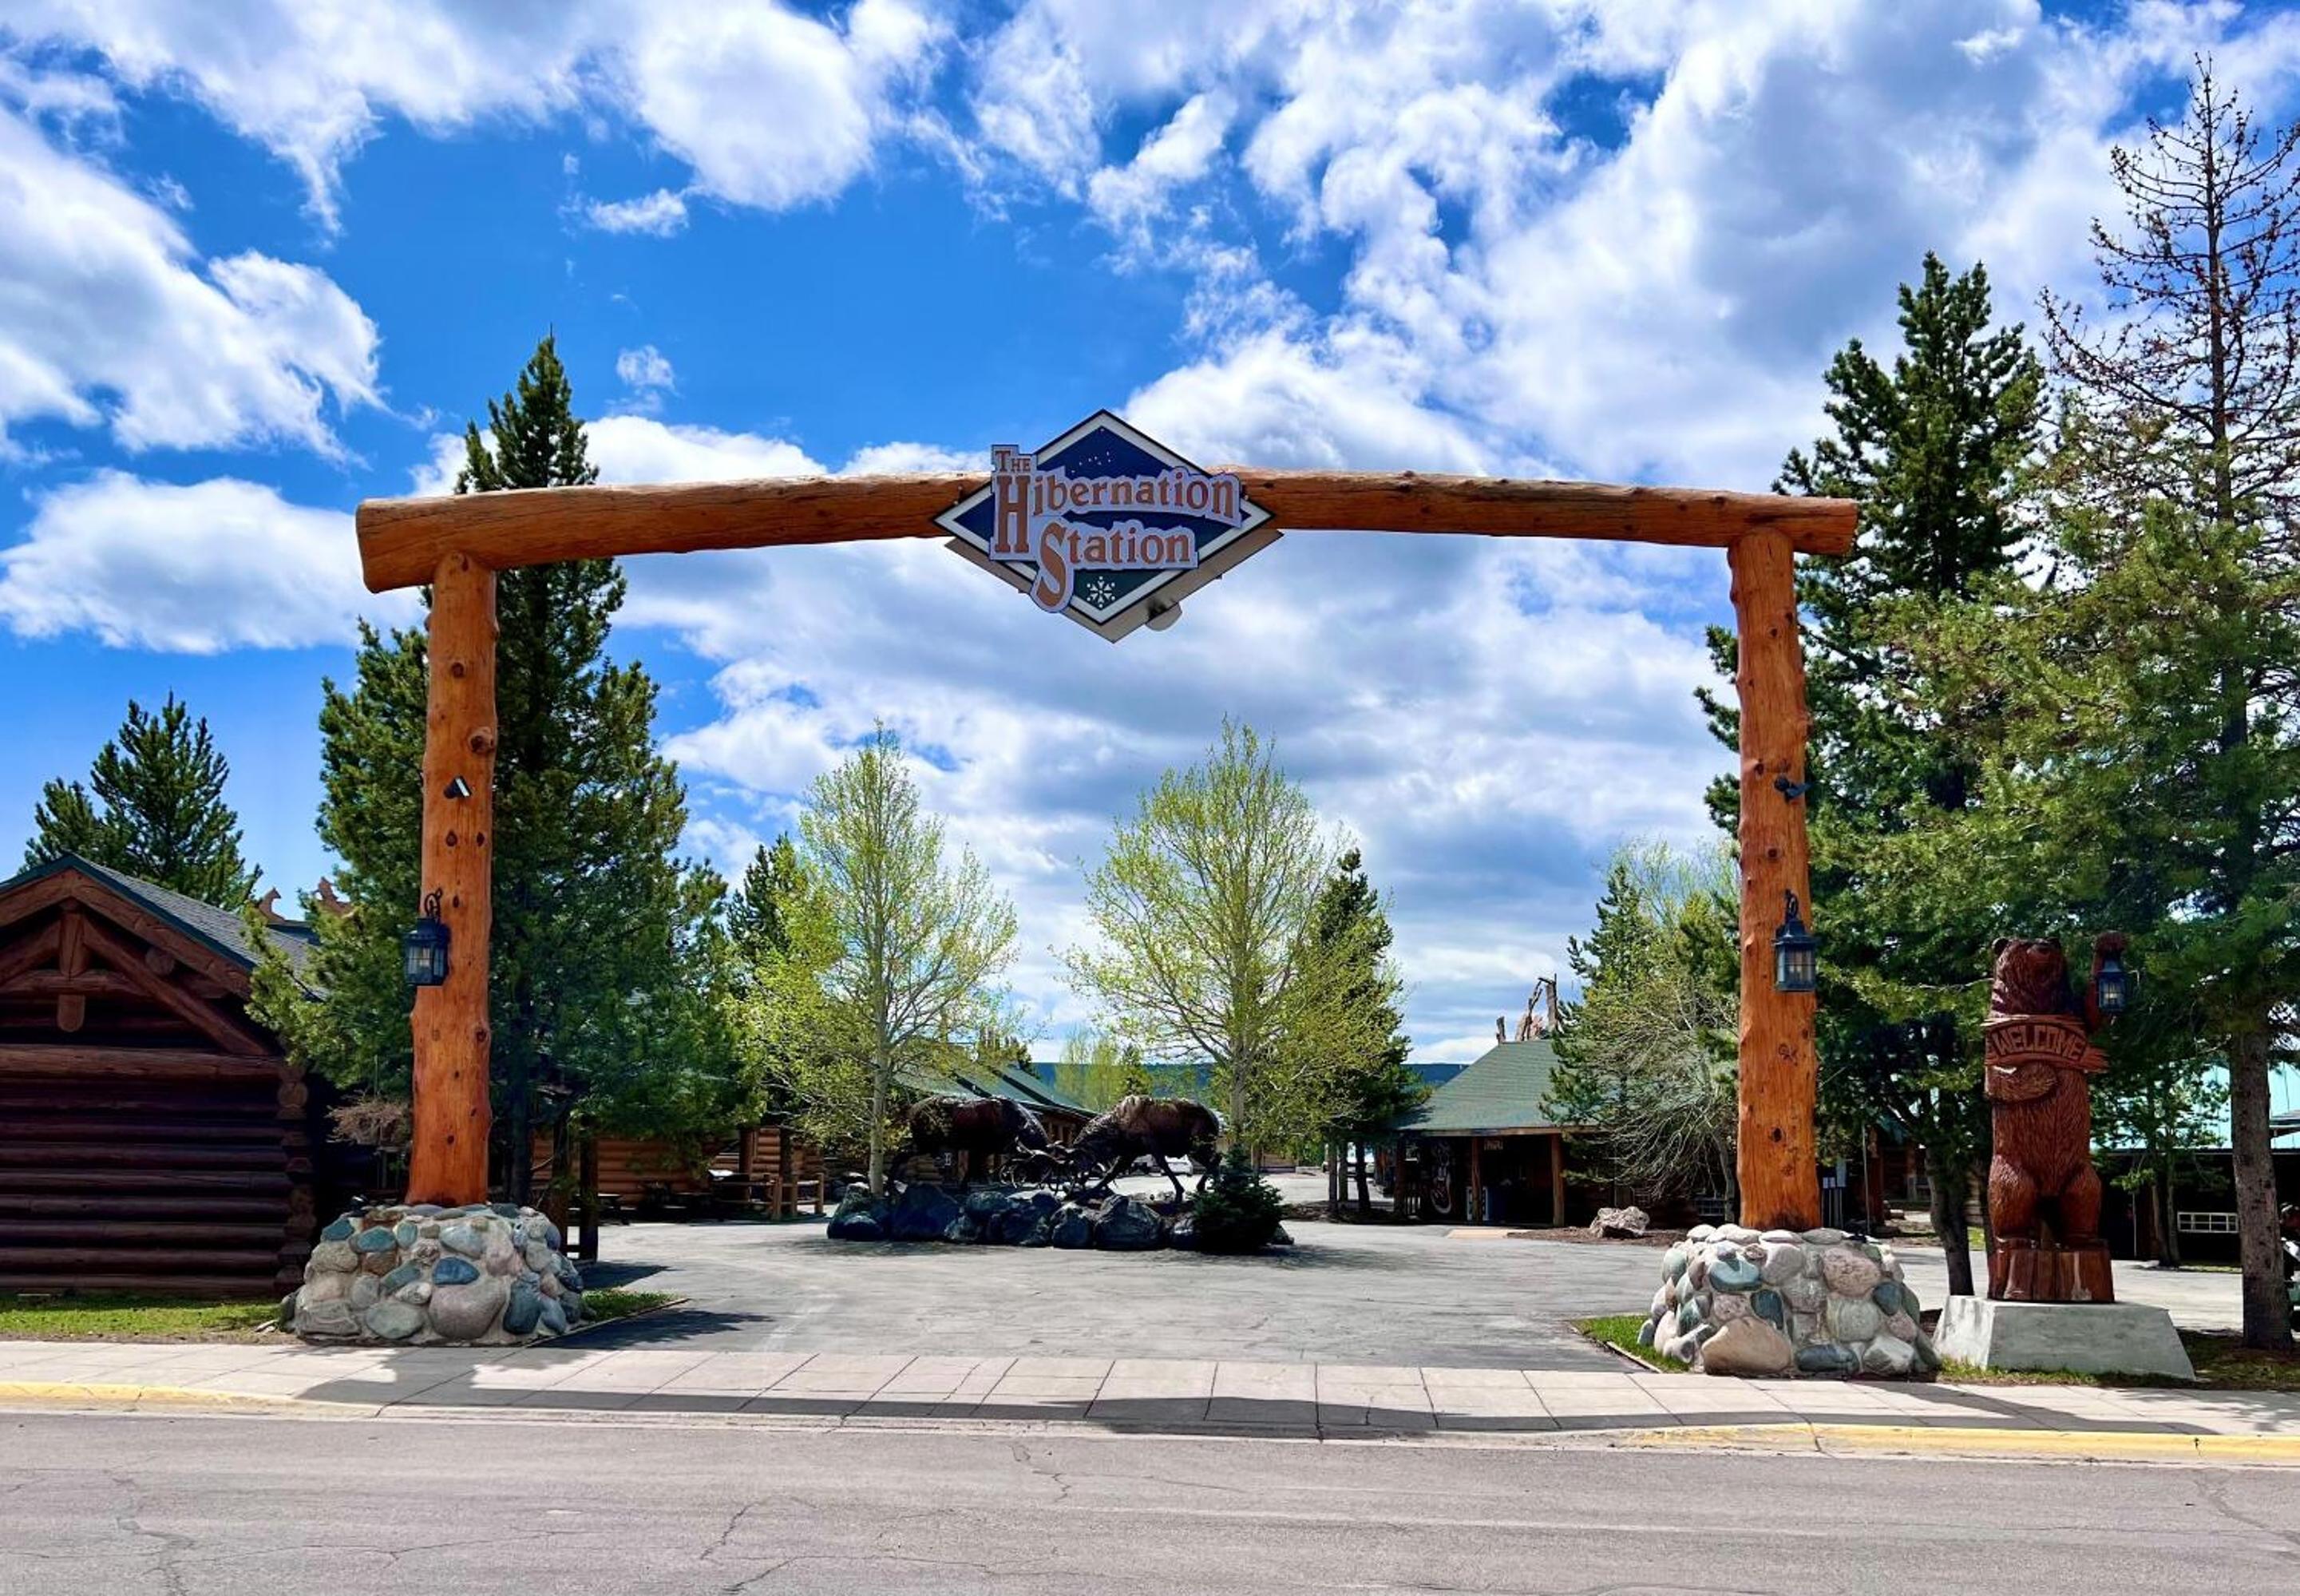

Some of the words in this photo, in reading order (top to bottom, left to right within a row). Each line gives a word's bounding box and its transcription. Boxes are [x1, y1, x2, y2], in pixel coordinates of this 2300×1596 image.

[995, 450, 1031, 472] THE
[995, 472, 1241, 552] Hibernation
[1037, 521, 1191, 607] Station
[1991, 1025, 2086, 1060] WELCOME
